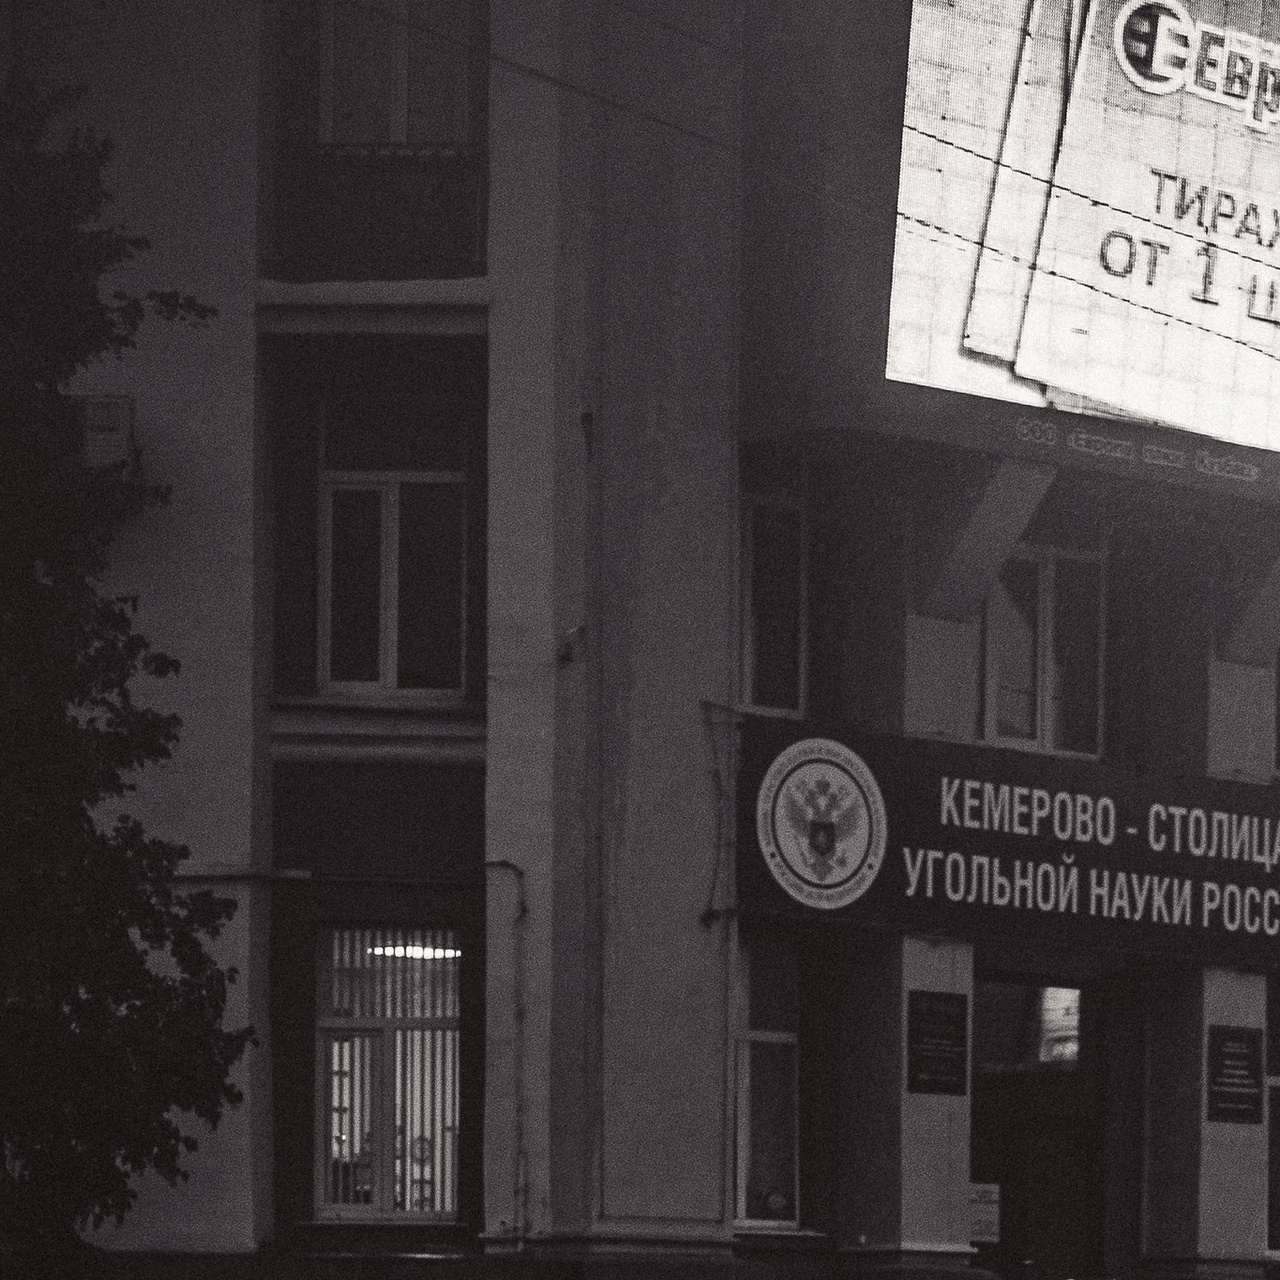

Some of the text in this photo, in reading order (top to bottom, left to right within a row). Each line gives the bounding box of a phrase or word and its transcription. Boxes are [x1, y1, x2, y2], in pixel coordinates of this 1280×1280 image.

[1099, 230, 1170, 286] ОТ
[1190, 242, 1220, 307] 1
[939, 776, 1116, 846] КЕМЕРОВО
[902, 847, 1079, 914] УГОЛЬНОЙ
[1088, 868, 1193, 926] НАУКИ
